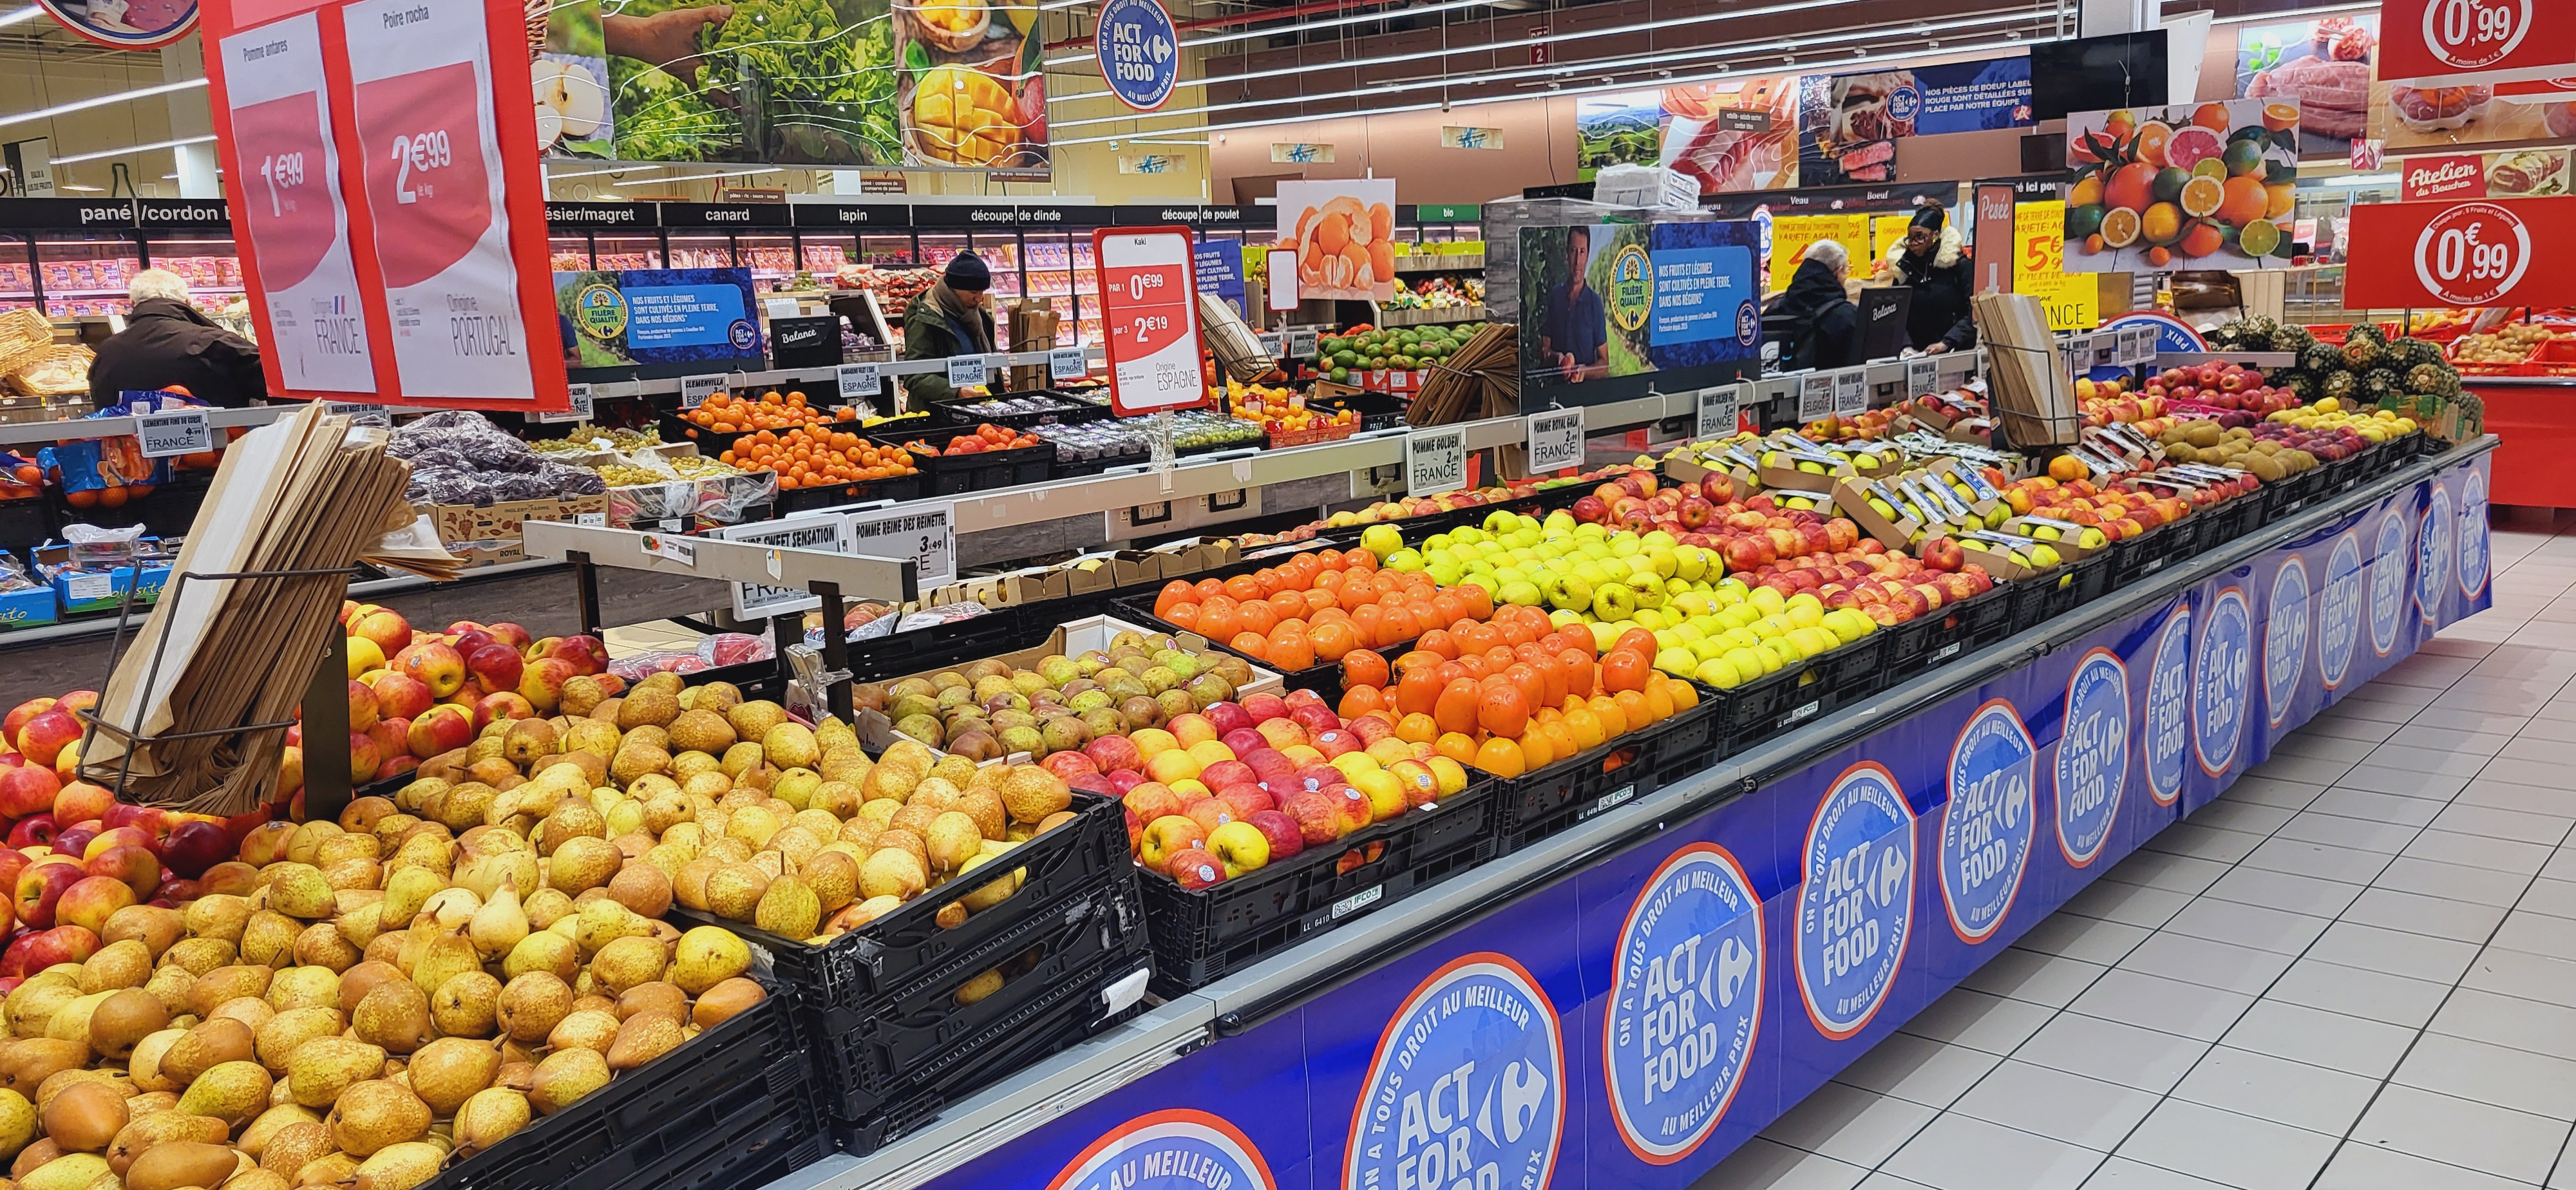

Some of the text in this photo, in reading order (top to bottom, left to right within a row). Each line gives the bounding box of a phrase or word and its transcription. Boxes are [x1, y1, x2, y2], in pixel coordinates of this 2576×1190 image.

[383, 5, 430, 30] Poire rocha
[1103, 0, 1164, 30] TOUS MEILLEUR
[1113, 22, 1142, 44] ACT
[1113, 43, 1142, 62] FOR
[1115, 62, 1155, 82] FOOD
[1137, 70, 1171, 102] MEILLEUR PRIX
[1942, 86, 1967, 95] PIÈCES
[1981, 82, 2006, 91] BOEUF
[2008, 80, 2032, 88] LABEL
[1924, 97, 2020, 113] PLACE PAR NOTRE ÉQUIPE
[1925, 97, 1951, 105] ROUGE
[1974, 90, 2016, 100] DÉTAILLÉES
[2018, 88, 2032, 96] SUR
[391, 130, 450, 205] 2€99
[1866, 190, 1889, 200] Boeuf
[2025, 182, 2038, 192] ici
[2416, 187, 2429, 197] du
[1790, 196, 1809, 205] Veau
[1980, 194, 2009, 221] Pesée
[80, 204, 131, 224] pané
[705, 209, 750, 221] canard
[838, 209, 867, 223] lapin
[971, 209, 1061, 223] découpe de dinde
[1162, 209, 1240, 222] découpe de poulet
[1443, 207, 1454, 218] bio
[1134, 238, 1147, 246] Kaki
[1779, 232, 1839, 242] VARIETE AGATA
[1199, 259, 1222, 268] LÉGUMES
[1207, 265, 1230, 275] CULTIVÉS
[1658, 260, 1713, 278] NOS FRUITS LÉGUMES
[1108, 283, 1121, 292] PAR
[1130, 273, 1164, 301] 0€99
[1201, 273, 1236, 283] PLEINE TERRE,
[1658, 275, 1732, 294] SONT CULTIVÉS PLEINE TERRE,
[632, 294, 696, 305] NOS FRUITS LÉGUMES
[1622, 285, 1643, 296] FILIÈRE
[446, 293, 478, 316] Origine
[634, 303, 719, 315] SONT CULTIVÉS PLEINE TERRE,
[1620, 294, 1645, 308] QUALITÉ
[1658, 295, 1672, 308] DANS
[590, 316, 619, 324] QUALITÉ
[591, 308, 615, 317] FILIÈRE
[635, 316, 650, 325] DANS
[1872, 303, 1897, 321] Balance
[314, 317, 361, 355] FRANCE
[451, 315, 516, 356] PORTUGAL
[781, 329, 817, 344] Balance
[1113, 326, 1124, 336] par
[1134, 316, 1168, 343] 2€19
[952, 372, 983, 382] ESPAGNE
[1054, 363, 1083, 373] ESPAGNE
[1155, 362, 1176, 373] Origine
[685, 377, 724, 388] CLEMENVILLA
[842, 381, 877, 391] ESPAGNE
[1157, 369, 1198, 392] ESPAGNE
[1912, 382, 1934, 394] FRANCE
[1803, 398, 1830, 413] BELGIQUE
[1839, 393, 1862, 407] FRANCE
[1533, 415, 1578, 434] POMME ROYAL GALA
[1701, 415, 1732, 431] FRANCE
[146, 437, 194, 449] FRANCE
[1413, 435, 1459, 455] POMME GOLDEN
[1535, 441, 1576, 460] FRANCE
[1414, 463, 1457, 484] FRANCE
[792, 526, 835, 547] SENSATION
[857, 522, 881, 538] POMME
[882, 519, 902, 536] REINE
[903, 516, 915, 531] DES
[500, 549, 520, 557] ROYAL
[920, 536, 942, 552] 3€49
[2327, 601, 2344, 631] FOR
[2207, 640, 2229, 682] ACT
[2076, 675, 2091, 709] DROIT
[2159, 662, 2184, 706] ACT
[2206, 672, 2227, 710] FOR
[2158, 698, 2180, 735] FOR
[2206, 696, 2233, 739] FOOD
[2070, 709, 2102, 758] ACT
[2156, 720, 2185, 765] FOOD
[2071, 747, 2099, 791] FOR
[1947, 719, 2025, 848] ON TOUS DROIT AU MEILLEUR
[2108, 773, 2121, 809] PRIX
[1615, 789, 1627, 801] IFCO
[1962, 768, 2002, 822] ACT
[2068, 773, 2105, 824] FOOD
[1960, 809, 1993, 860] FOR
[1806, 785, 1899, 934] ON A TOUS DROIT AU MEILLEUR
[1960, 837, 2008, 896] FOOD
[1823, 840, 1871, 905] ACT
[1970, 836, 2027, 923] AU MEILLEUR PRIX
[1354, 890, 1372, 905] IFCO
[1823, 888, 1864, 947] FOR
[1619, 870, 1739, 1047] ON A TOUS DROIT AU MEILLEUR
[1823, 917, 1880, 987] FOOD
[1643, 933, 1702, 1012] ACT
[1836, 913, 1904, 1015] AU MEILLEUR PRIX
[1642, 988, 1698, 1059] FOR
[1367, 985, 1530, 1160] A TOUS DROIT AU MEILLEUR
[1643, 1021, 1718, 1106] FOOD
[1660, 1014, 1750, 1137] AU MEILLEUR PRIX
[1397, 1059, 1475, 1159] ACT
[1397, 1126, 1473, 1190] FOR
[1110, 1150, 1233, 1190] AU MEILLEUR
